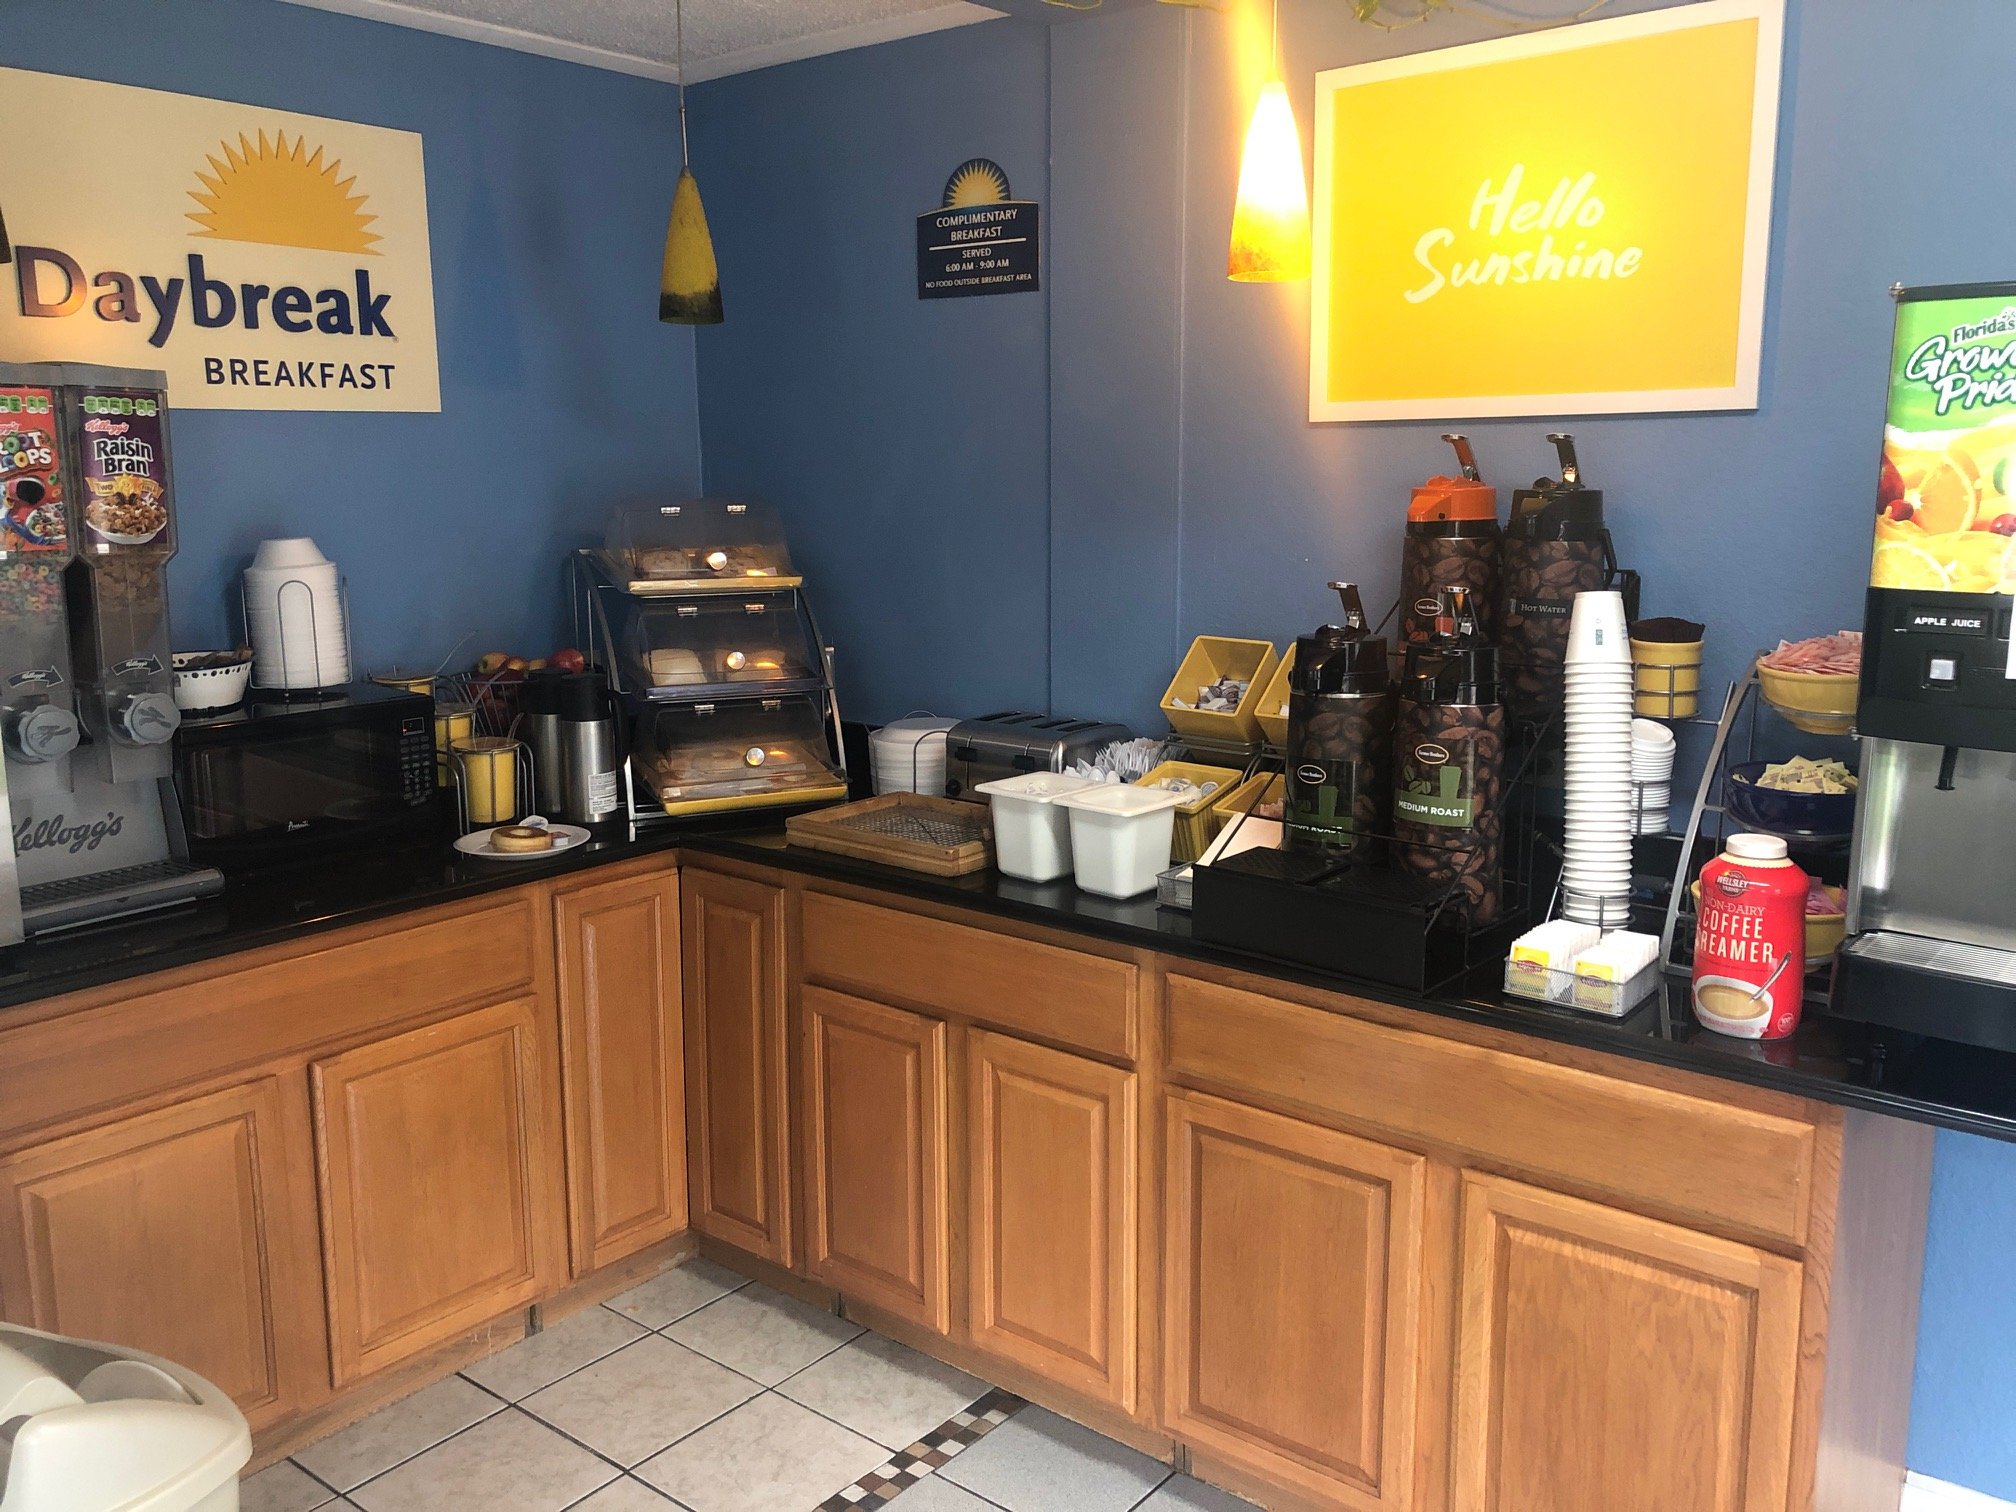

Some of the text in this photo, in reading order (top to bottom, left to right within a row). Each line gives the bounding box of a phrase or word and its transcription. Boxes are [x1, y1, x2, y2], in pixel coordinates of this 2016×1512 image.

[1469, 162, 1605, 237] Hello
[936, 208, 1018, 228] COMPLIMENTARY
[951, 226, 1003, 242] BREAKFAST
[962, 248, 992, 259] SERVED
[945, 263, 960, 272] 6:00
[961, 262, 974, 271] AM
[979, 260, 995, 270] 9:00
[996, 259, 1010, 268] AM
[1403, 227, 1644, 304] Sunshine
[925, 273, 1032, 289] NO FOOD OUTSIDE BREAKFAST AREA
[15, 245, 396, 348] Daybreak
[204, 357, 396, 390] BREAKFAST
[94, 437, 153, 461] Raisin
[103, 457, 150, 477] Bran
[1914, 617, 1982, 628] APPLE JUICE
[1430, 807, 1465, 817] ROAST
[1716, 875, 1749, 888] WELLSLEY
[1702, 906, 1764, 939] COFFEE
